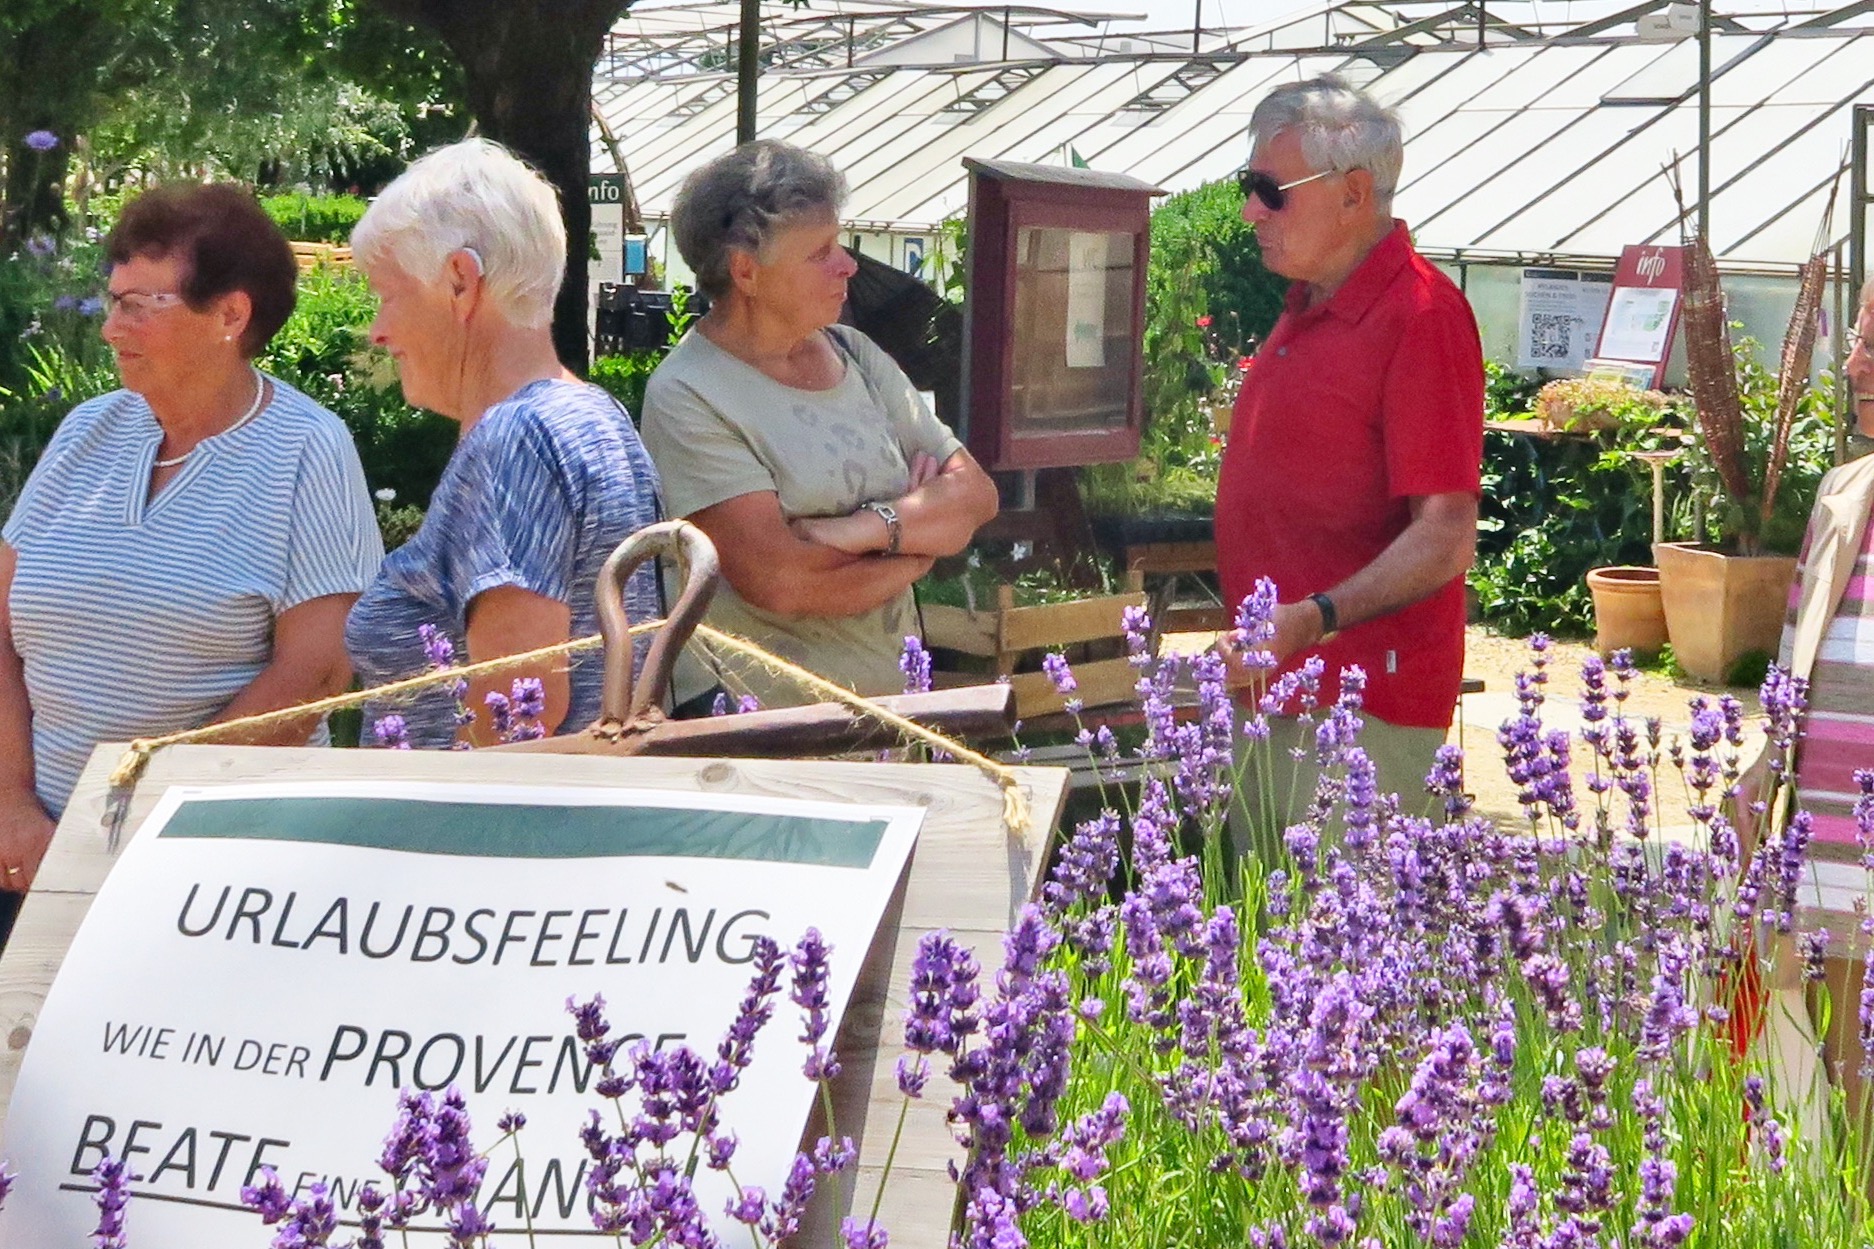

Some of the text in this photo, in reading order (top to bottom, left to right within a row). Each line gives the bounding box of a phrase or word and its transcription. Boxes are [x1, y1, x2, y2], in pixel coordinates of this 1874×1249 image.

[588, 180, 620, 201] nfo
[1635, 246, 1666, 287] info
[176, 882, 770, 968] URLAUBSFEELING
[102, 1020, 176, 1061] WIE
[181, 1031, 226, 1067] IN
[233, 1039, 312, 1080] DER
